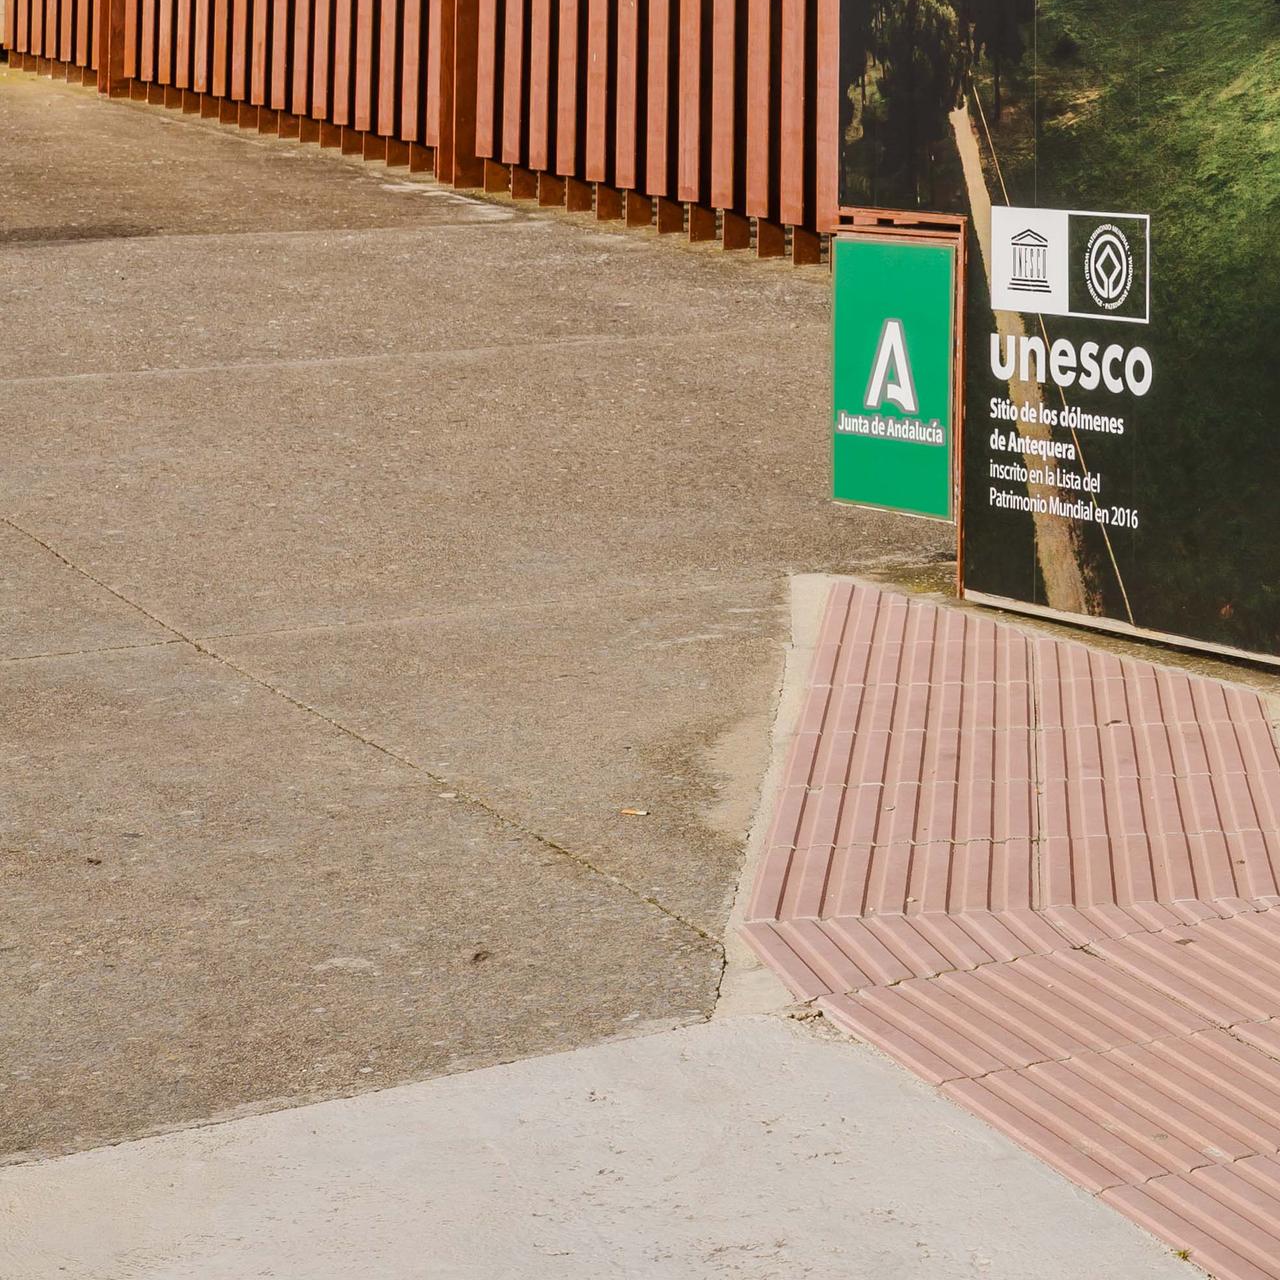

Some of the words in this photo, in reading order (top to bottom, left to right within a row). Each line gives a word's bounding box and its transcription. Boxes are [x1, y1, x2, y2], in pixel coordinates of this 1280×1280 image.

[990, 332, 1153, 397] unesco
[838, 412, 869, 434] Junta
[871, 416, 885, 435] de
[886, 419, 943, 444] Andalucía
[990, 397, 1018, 422] Sitio
[1020, 401, 1037, 423] de
[1039, 402, 1058, 426] los
[1060, 406, 1125, 435] dólmenes
[990, 428, 1006, 451] de
[1007, 431, 1076, 461] Antequera
[990, 459, 1028, 483] inscrito
[1029, 468, 1043, 485] en
[1045, 466, 1055, 486] la
[1057, 467, 1081, 490] Lista
[1083, 472, 1101, 494] del
[989, 487, 1047, 514] Patrimonio
[1049, 496, 1093, 521] Mundial
[1095, 508, 1110, 525] en
[1111, 506, 1139, 529] 2016
